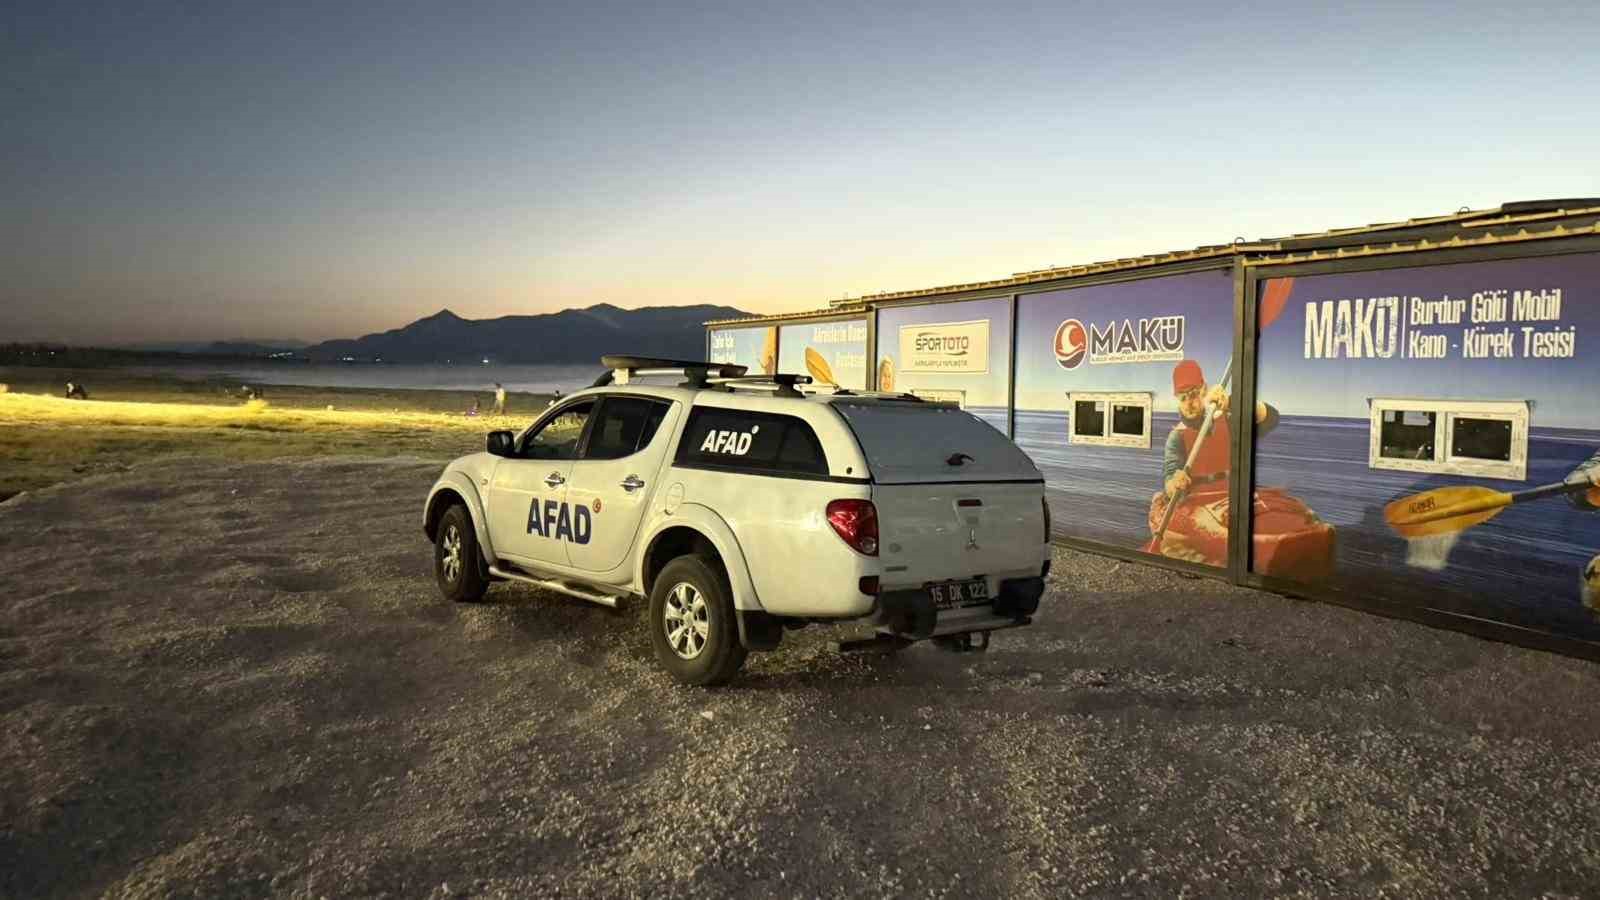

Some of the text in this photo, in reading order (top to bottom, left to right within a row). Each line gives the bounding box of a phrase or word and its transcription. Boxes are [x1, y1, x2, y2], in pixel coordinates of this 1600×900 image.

[1410, 288, 1561, 325] Burdur Gölü Mobil
[1090, 316, 1184, 355] MAKÜ
[1304, 296, 1399, 359] MAKÜ
[1409, 331, 1447, 358] Kano
[1463, 327, 1514, 358] Kürek
[1521, 326, 1575, 358] Tesisi
[701, 430, 752, 456] AFAD
[527, 498, 592, 545] AFAD
[930, 586, 943, 602] 15
[969, 582, 987, 598] 122
